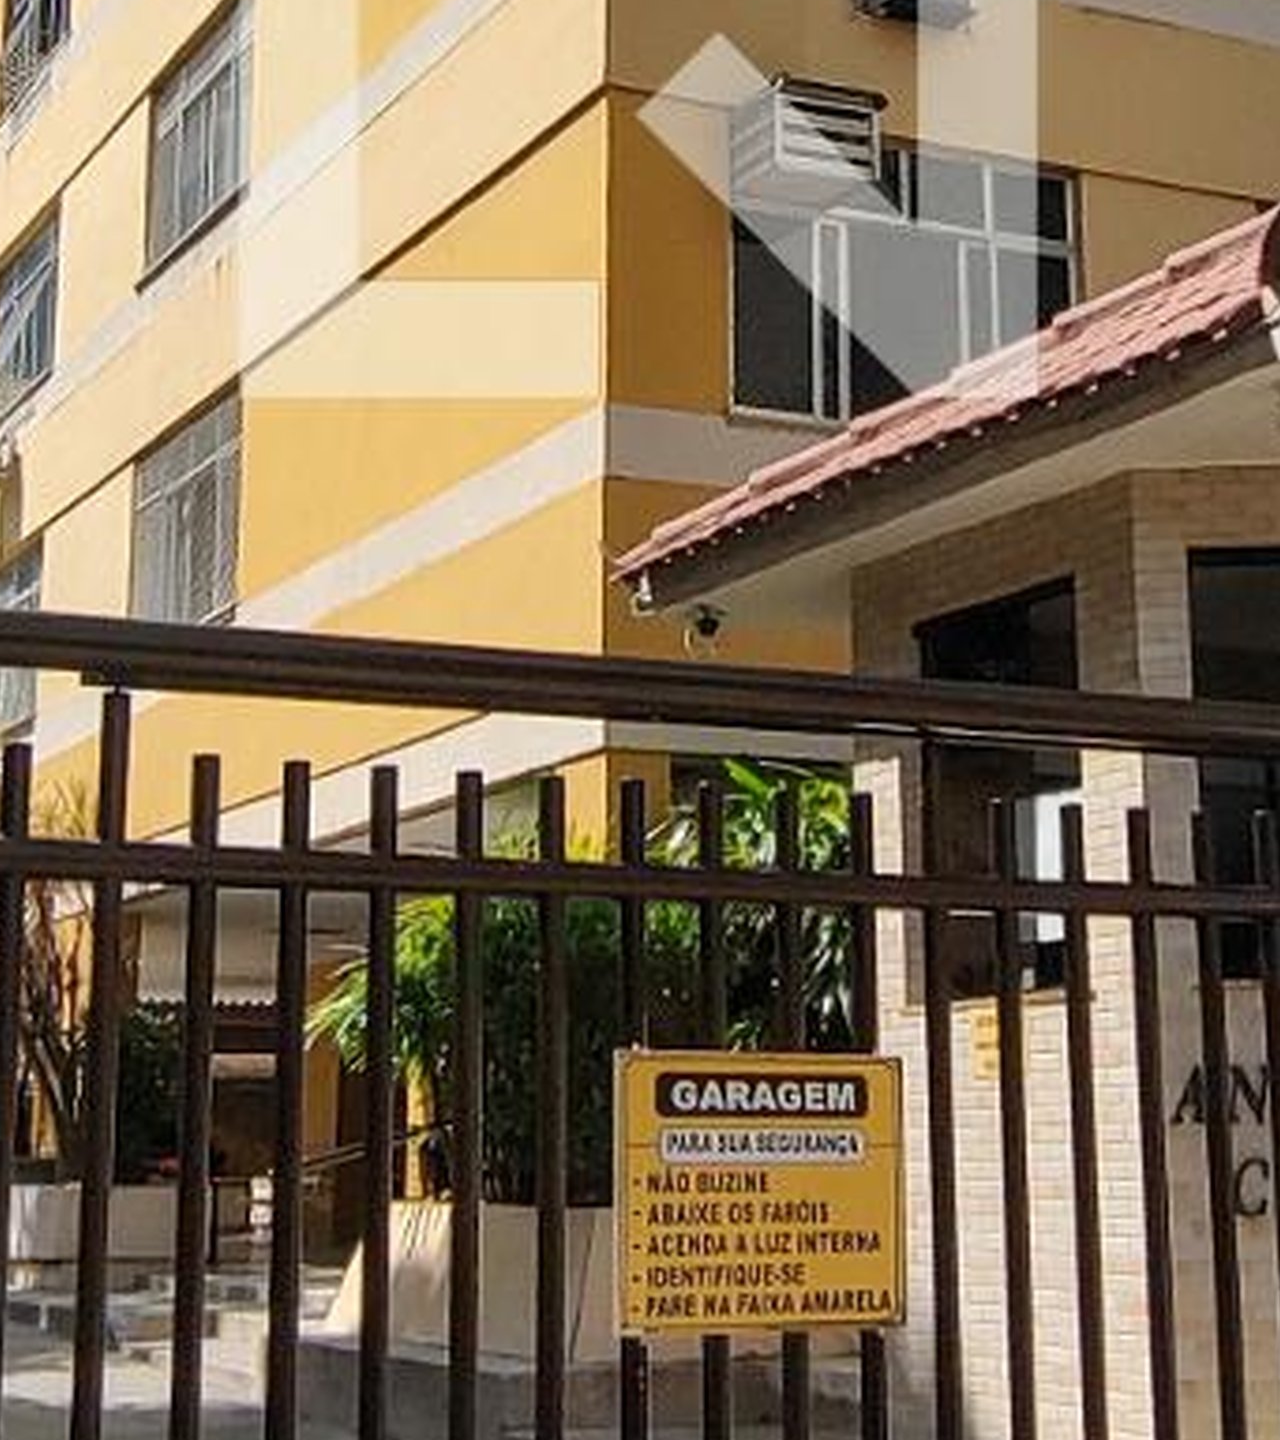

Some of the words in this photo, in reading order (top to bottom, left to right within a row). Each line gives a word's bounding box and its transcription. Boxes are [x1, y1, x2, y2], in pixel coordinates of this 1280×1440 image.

[671, 1079, 857, 1112] GARAGEM
[667, 1132, 712, 1153] PARA
[718, 1132, 751, 1153] SUA
[756, 1132, 859, 1156] SEGURANÇA
[646, 1169, 690, 1194] NÃO
[696, 1172, 770, 1195] BUZINE
[647, 1202, 721, 1227] ABAIXE
[728, 1201, 755, 1225] OS
[761, 1198, 830, 1226] FARÓIS
[646, 1232, 728, 1258] ACENDA
[736, 1233, 749, 1257] A
[754, 1232, 792, 1255] LUZ
[796, 1230, 882, 1256] INTERNA
[646, 1262, 807, 1288] IDENTIFIQUE-SE
[646, 1292, 697, 1319] PARE
[703, 1292, 731, 1318] NA
[735, 1291, 794, 1317] FAIXA
[800, 1287, 893, 1314] AMARELA
